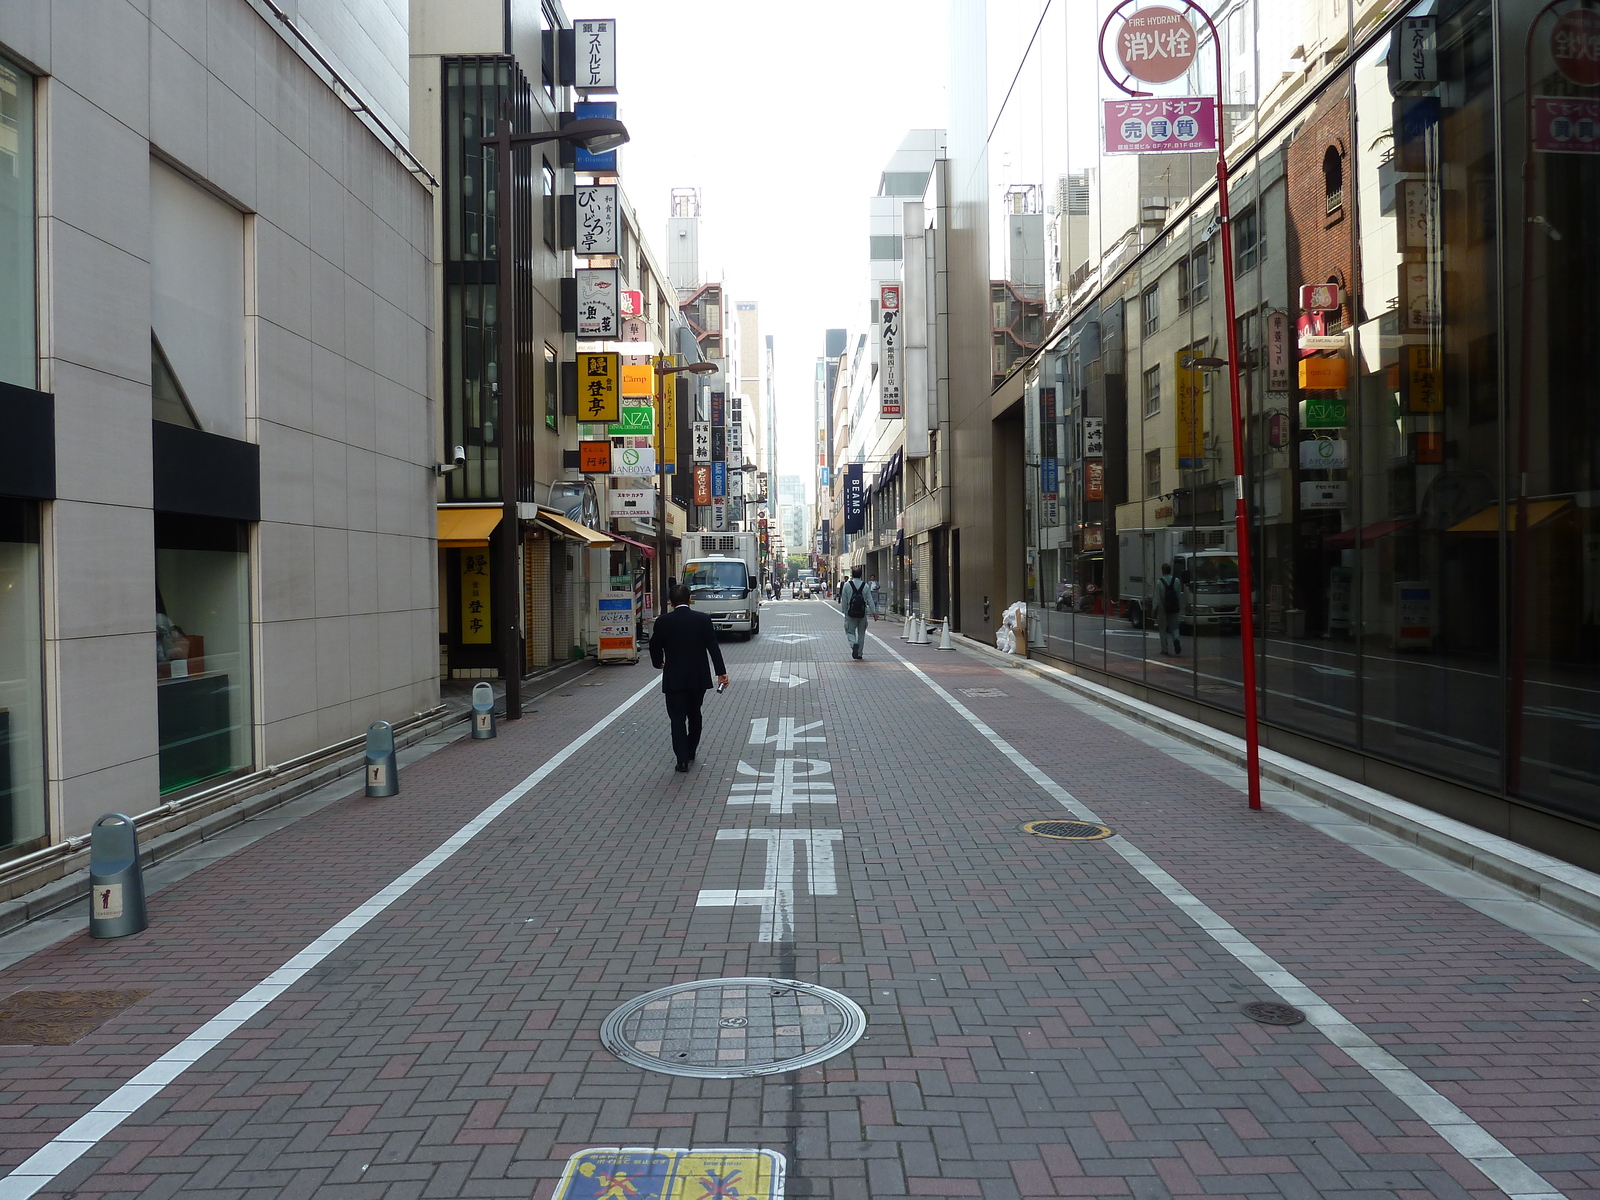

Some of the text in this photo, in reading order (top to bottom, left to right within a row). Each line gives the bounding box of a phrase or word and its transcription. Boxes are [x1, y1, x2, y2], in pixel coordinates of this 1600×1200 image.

[582, 22, 607, 33] 銀座
[1128, 14, 1181, 27] FIRE HYDRANT
[1123, 27, 1191, 62] 消火栓
[589, 33, 602, 86] スバルビル
[1115, 101, 1202, 118] ブランドオフ
[1124, 119, 1195, 139] 売買質
[578, 188, 604, 251] びいどろ亭
[883, 309, 899, 346] がんこ
[588, 357, 608, 375] 鰻
[623, 375, 647, 383] Lamp
[587, 380, 606, 417] 登亭
[622, 412, 652, 425] NZA
[852, 479, 861, 514] BEAMS
[463, 554, 488, 576] 鰻
[468, 600, 483, 633] 登亭
[695, 716, 844, 943] 止まれ
